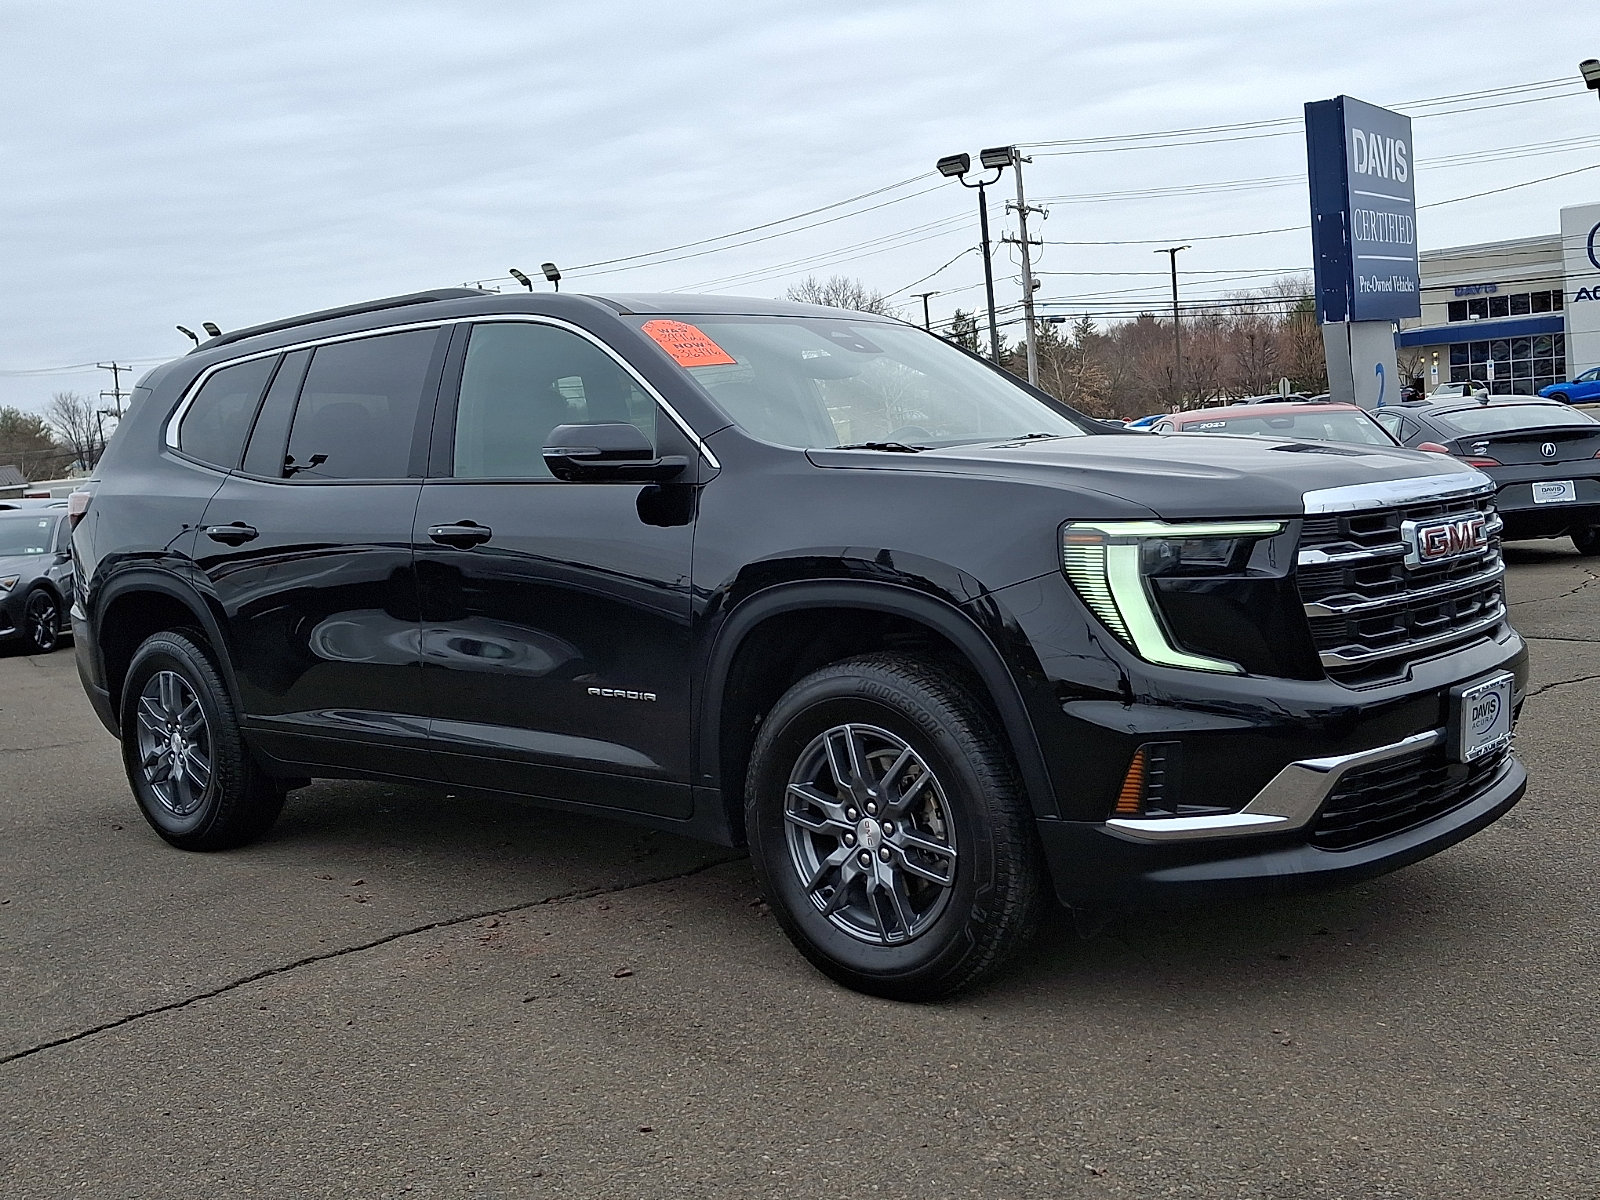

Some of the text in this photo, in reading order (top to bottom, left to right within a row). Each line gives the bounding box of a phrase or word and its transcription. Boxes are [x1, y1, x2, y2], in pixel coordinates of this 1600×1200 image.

[1352, 128, 1409, 183] DAVIS
[1354, 208, 1414, 245] CERTIFIED
[1359, 275, 1415, 293] Pre-Owned Vehicles
[1454, 282, 1498, 297] DAVIS
[1423, 520, 1487, 557] GMC
[587, 687, 657, 702] ACADIA
[855, 677, 946, 738] BRIDGESTONE
[1472, 698, 1496, 722] DAVIS
[1471, 715, 1494, 730] ACURA
[863, 820, 873, 847] GMC
